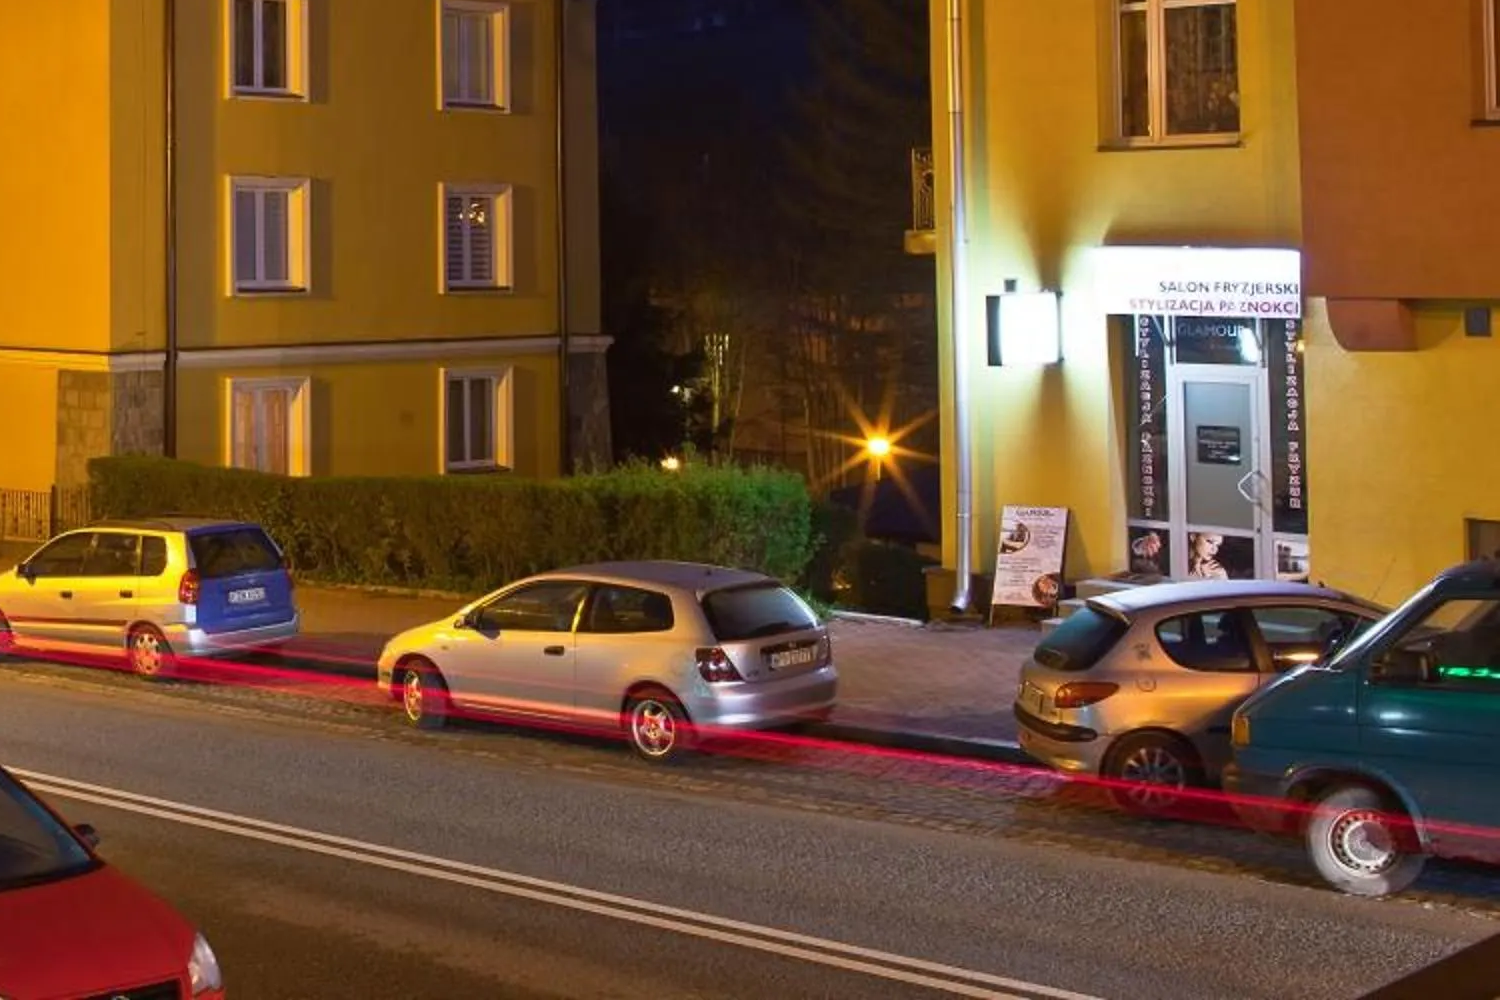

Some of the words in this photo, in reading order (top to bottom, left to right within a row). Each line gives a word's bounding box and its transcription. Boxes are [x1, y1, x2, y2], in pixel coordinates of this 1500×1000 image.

[1159, 281, 1210, 293] SALON
[1214, 282, 1299, 296] FRYZJERSKI
[1130, 299, 1215, 314] STYLIZACJA
